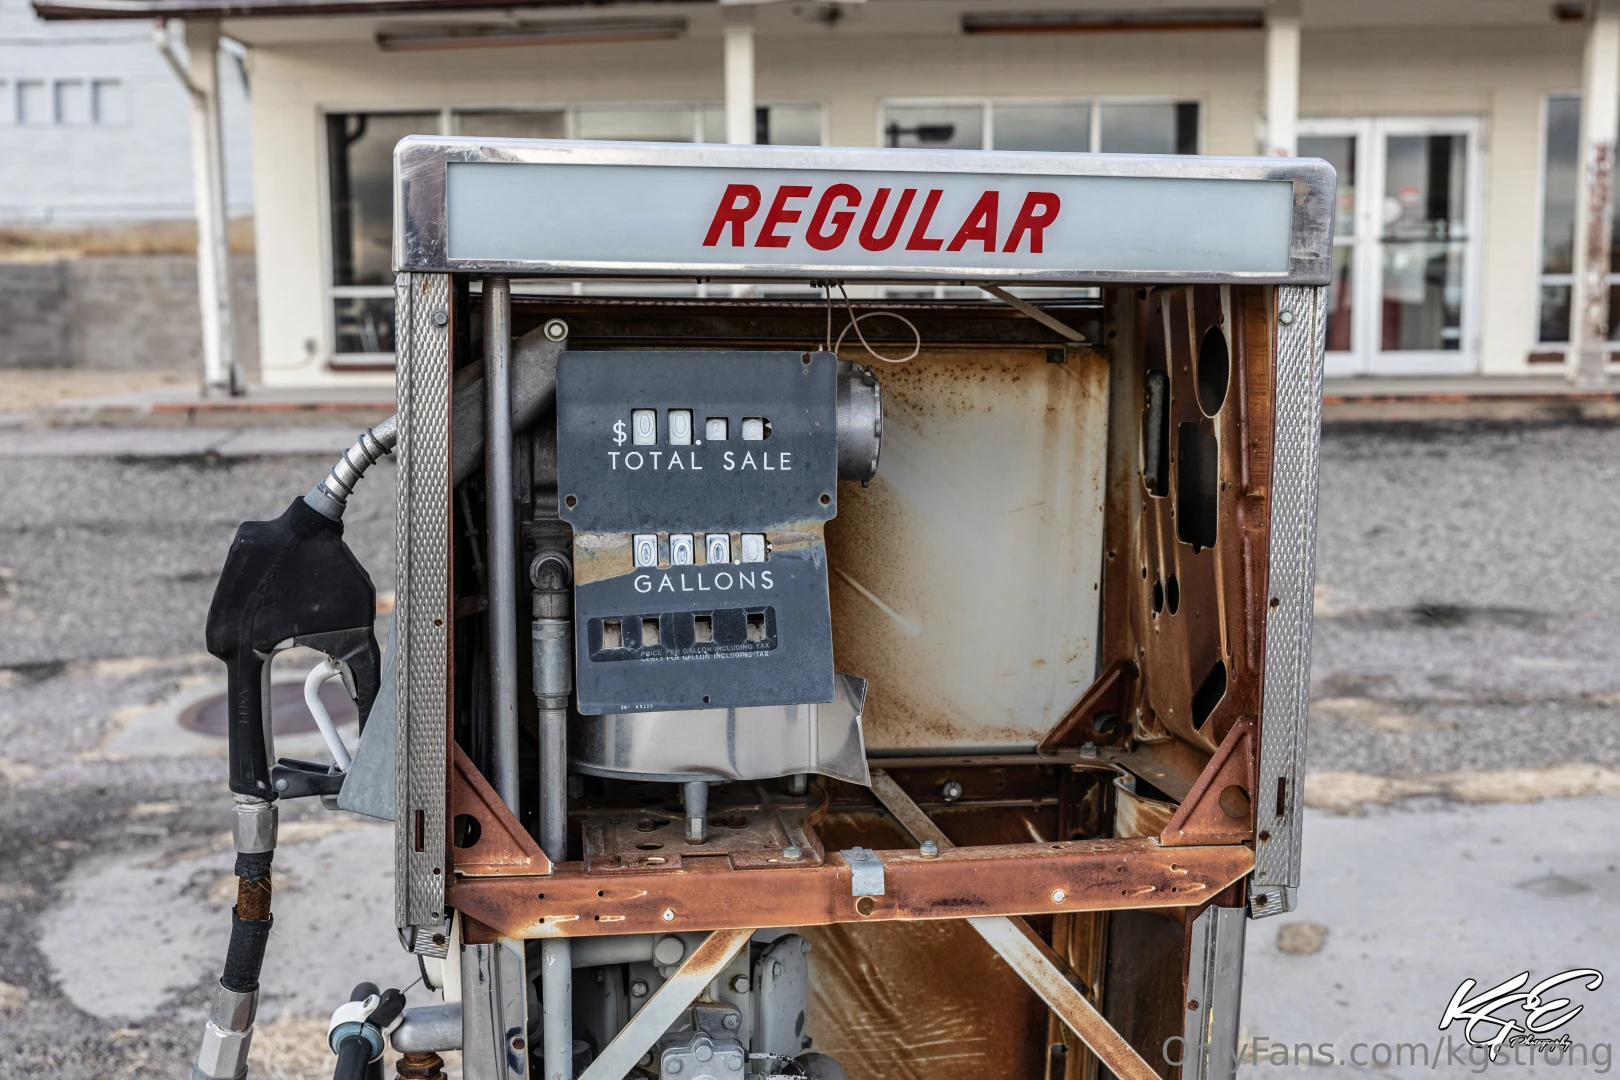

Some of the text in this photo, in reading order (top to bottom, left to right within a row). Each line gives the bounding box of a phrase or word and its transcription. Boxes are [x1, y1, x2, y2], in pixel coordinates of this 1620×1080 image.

[702, 183, 1061, 253] REGULAR
[607, 450, 792, 471] TOTAL SALE
[633, 570, 774, 593] GALLONS
[640, 649, 663, 657] PRICE
[666, 648, 680, 656] PER
[682, 645, 712, 654] GALLON
[715, 643, 753, 651] INCLUDING
